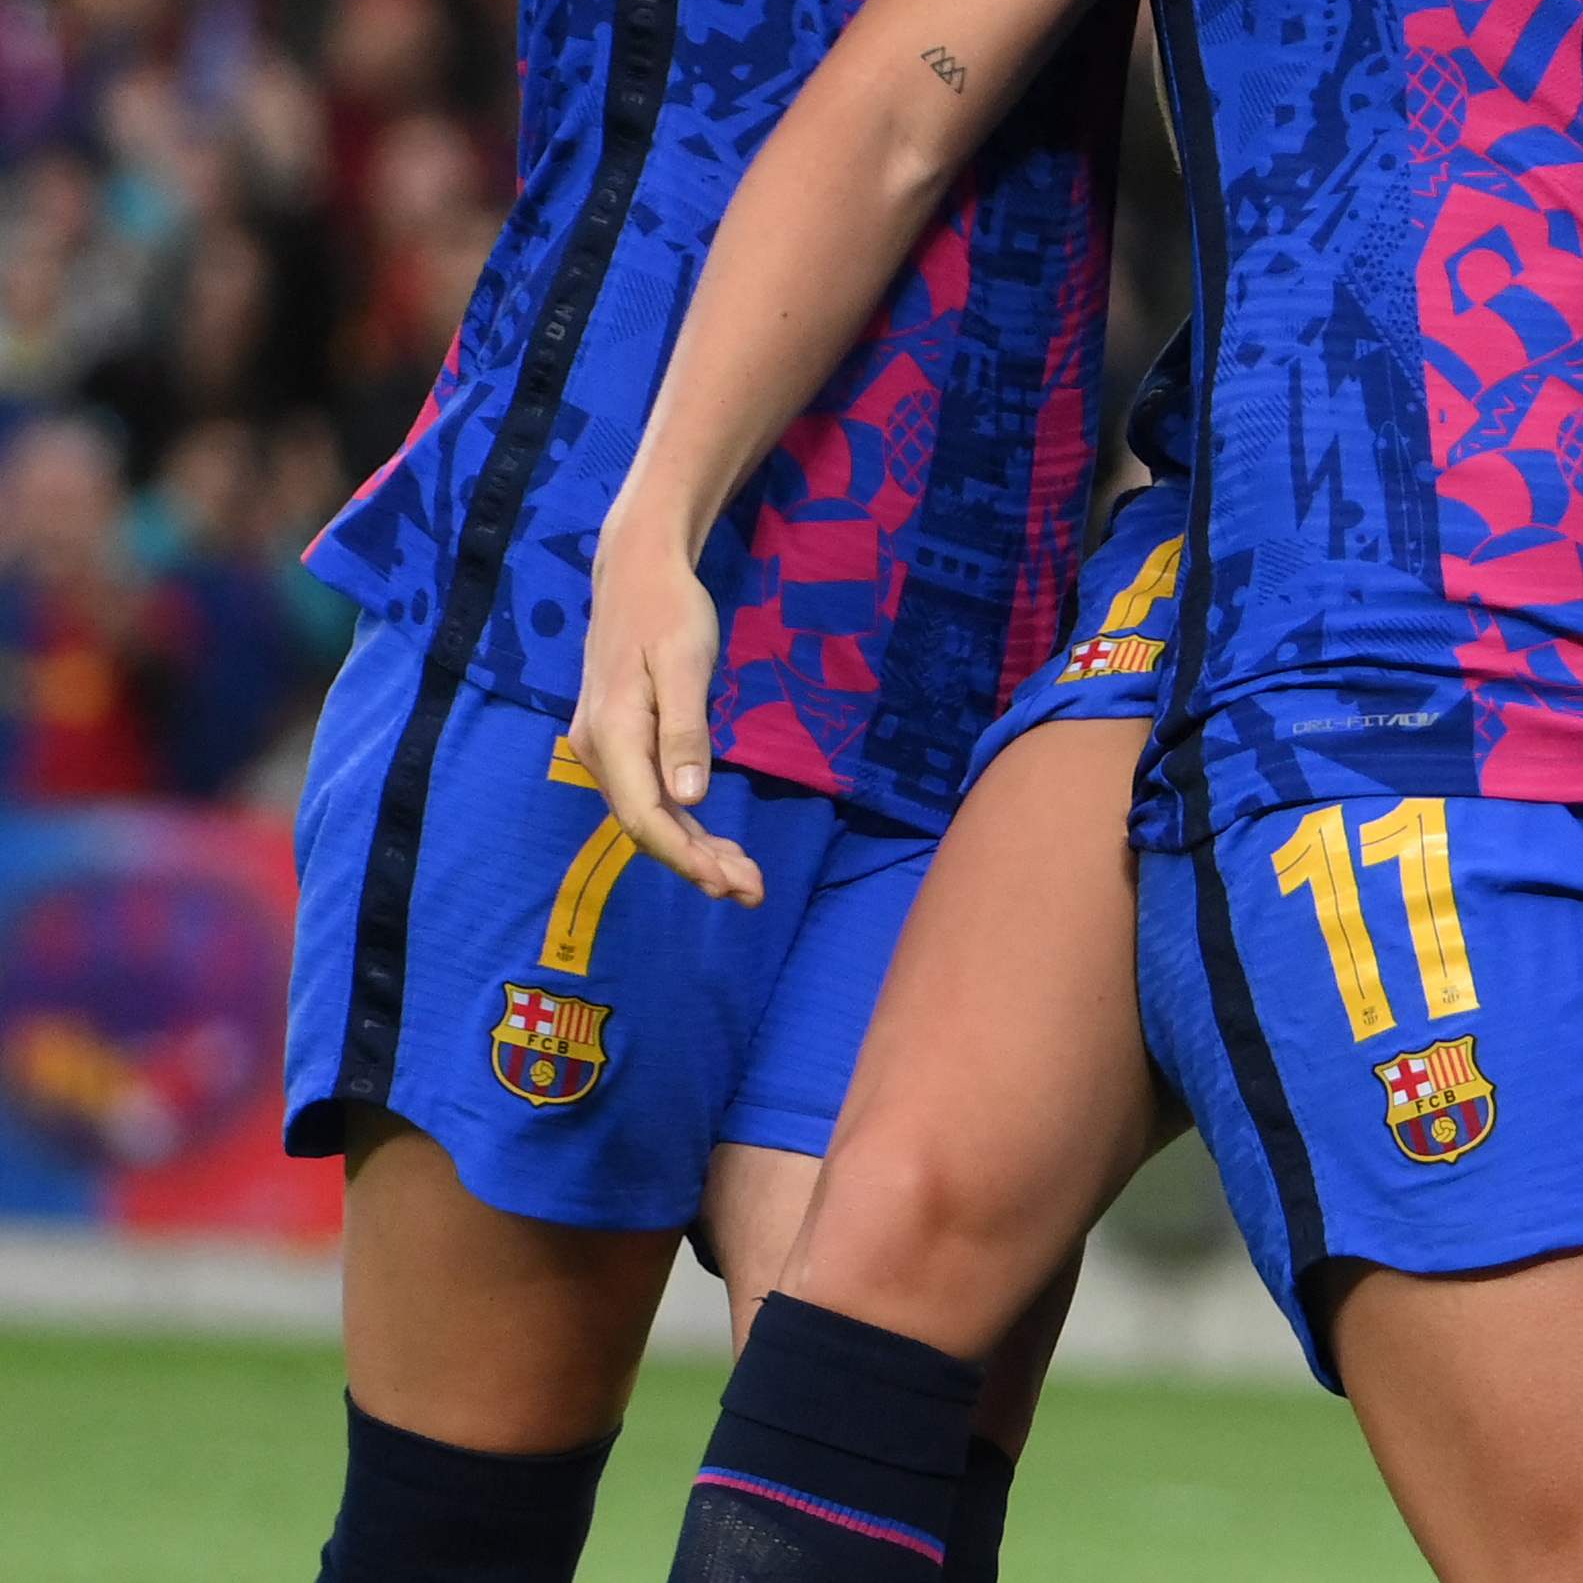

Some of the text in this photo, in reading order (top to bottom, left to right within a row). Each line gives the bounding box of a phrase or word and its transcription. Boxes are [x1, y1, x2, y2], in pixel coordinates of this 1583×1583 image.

[538, 735, 638, 977] 7
[1270, 798, 1481, 1044] 11
[526, 1033, 569, 1055] FCB
[1415, 1089, 1456, 1114] FCB
